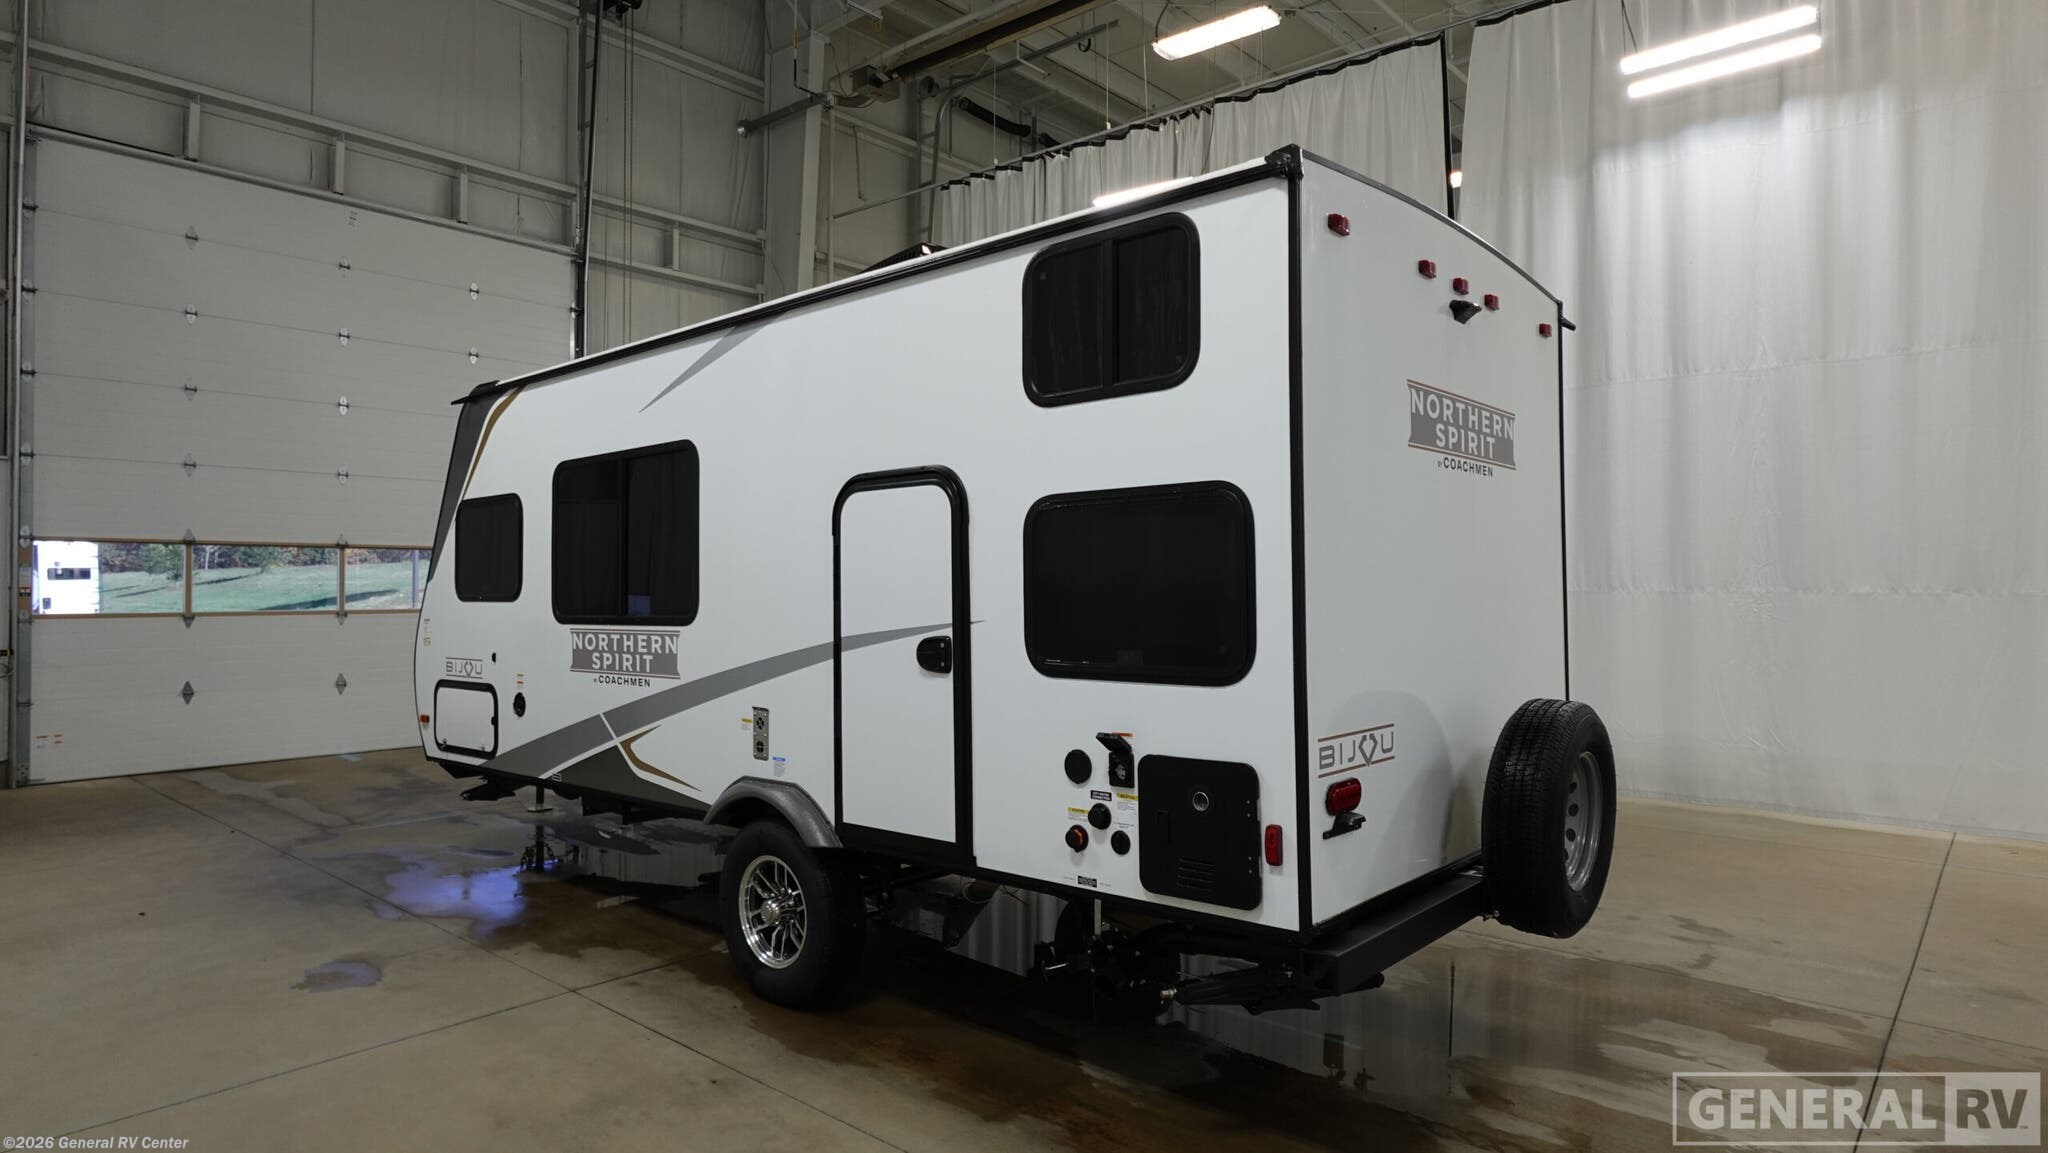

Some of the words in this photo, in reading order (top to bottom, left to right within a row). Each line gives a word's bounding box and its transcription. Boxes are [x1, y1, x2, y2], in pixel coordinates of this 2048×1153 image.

[1411, 388, 1513, 441] NORTHERN
[1435, 423, 1495, 459] SPIRIT
[1443, 457, 1494, 477] COACHMEN
[572, 633, 678, 654] NORTHERN
[445, 661, 483, 677] BIJOU
[592, 652, 653, 673] SPIRIT
[598, 675, 651, 687] COACHMEN
[1319, 731, 1394, 770] BIJOU
